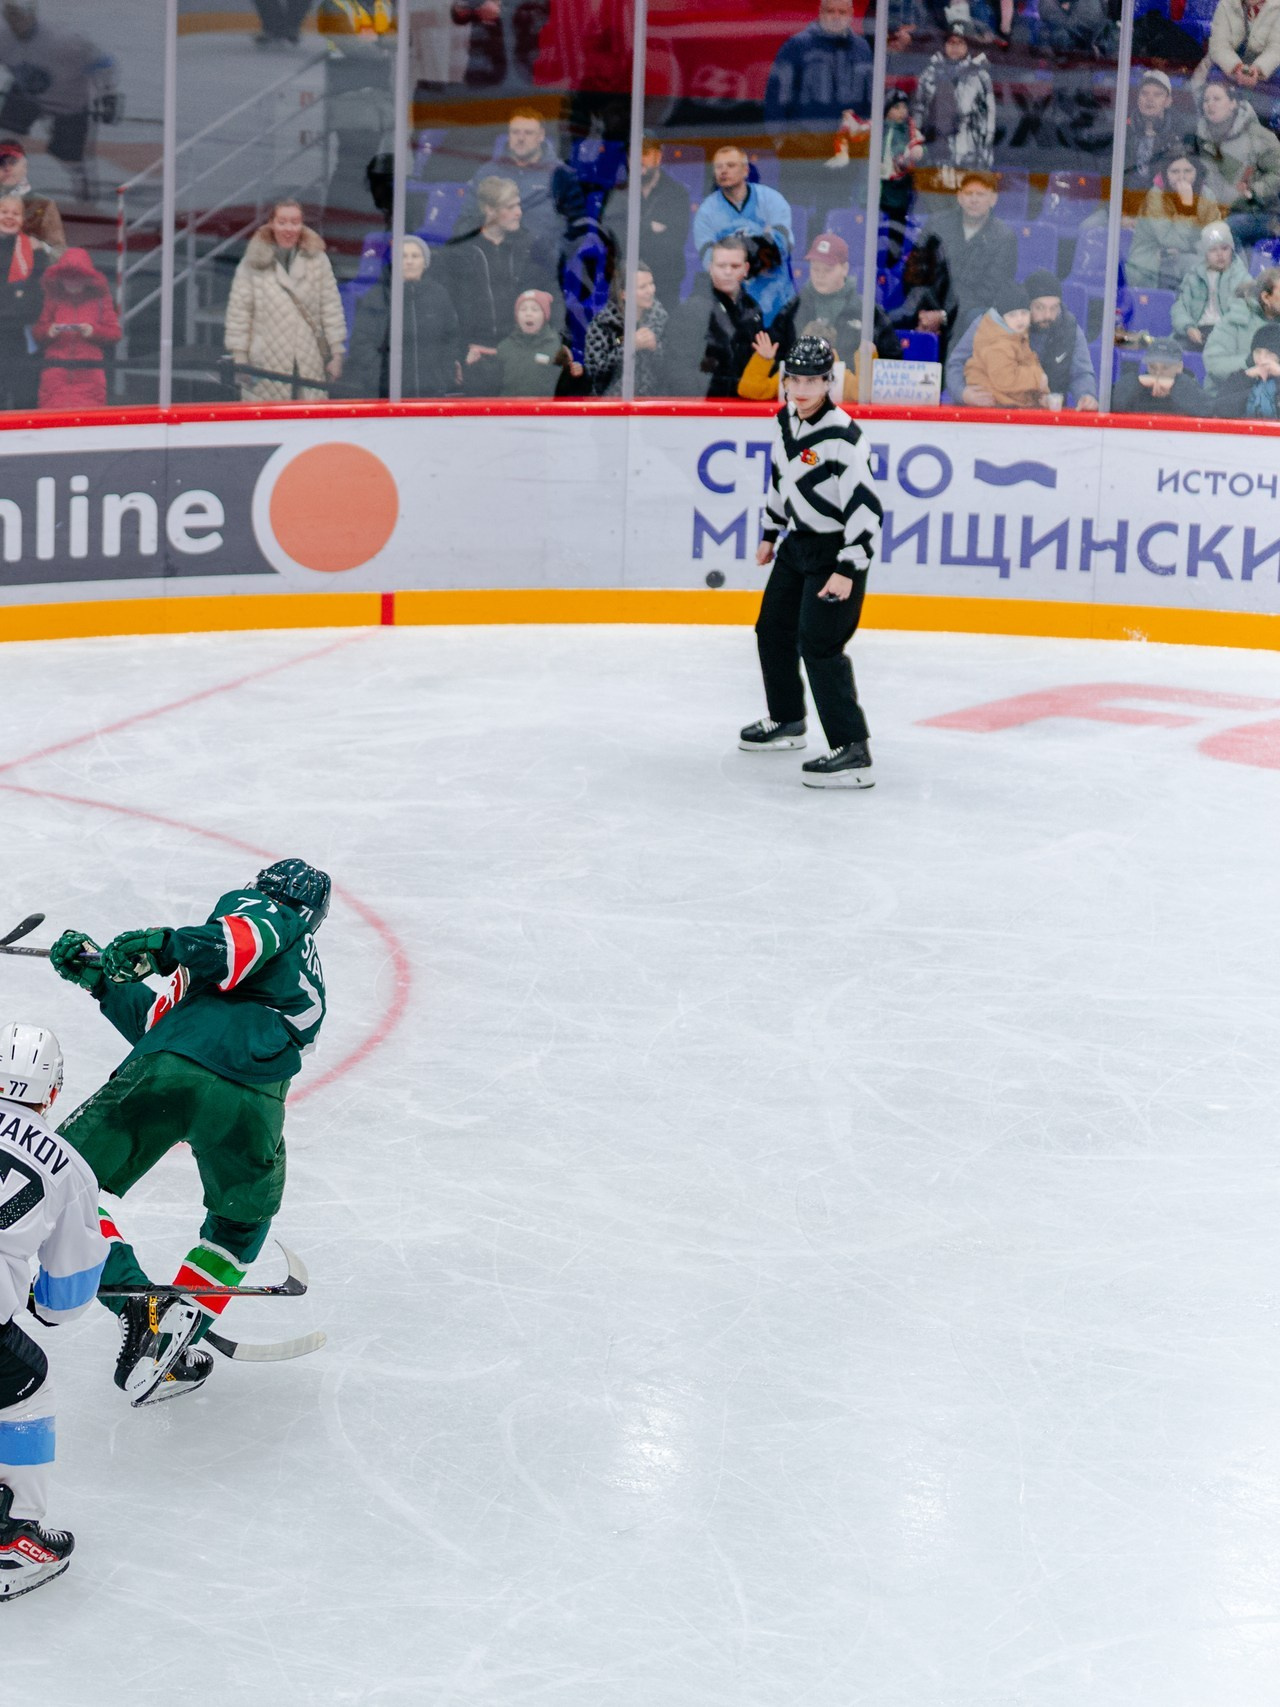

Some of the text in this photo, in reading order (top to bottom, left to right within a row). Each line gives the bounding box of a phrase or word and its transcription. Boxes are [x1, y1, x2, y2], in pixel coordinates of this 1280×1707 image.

[698, 440, 953, 498] СТО
[1157, 467, 1278, 499] ИСТОЧ
[692, 506, 1280, 583] МИЩИНСКИ
[299, 905, 314, 922] 71
[9, 1080, 28, 1098] 77
[18, 1539, 54, 1564] CCM
